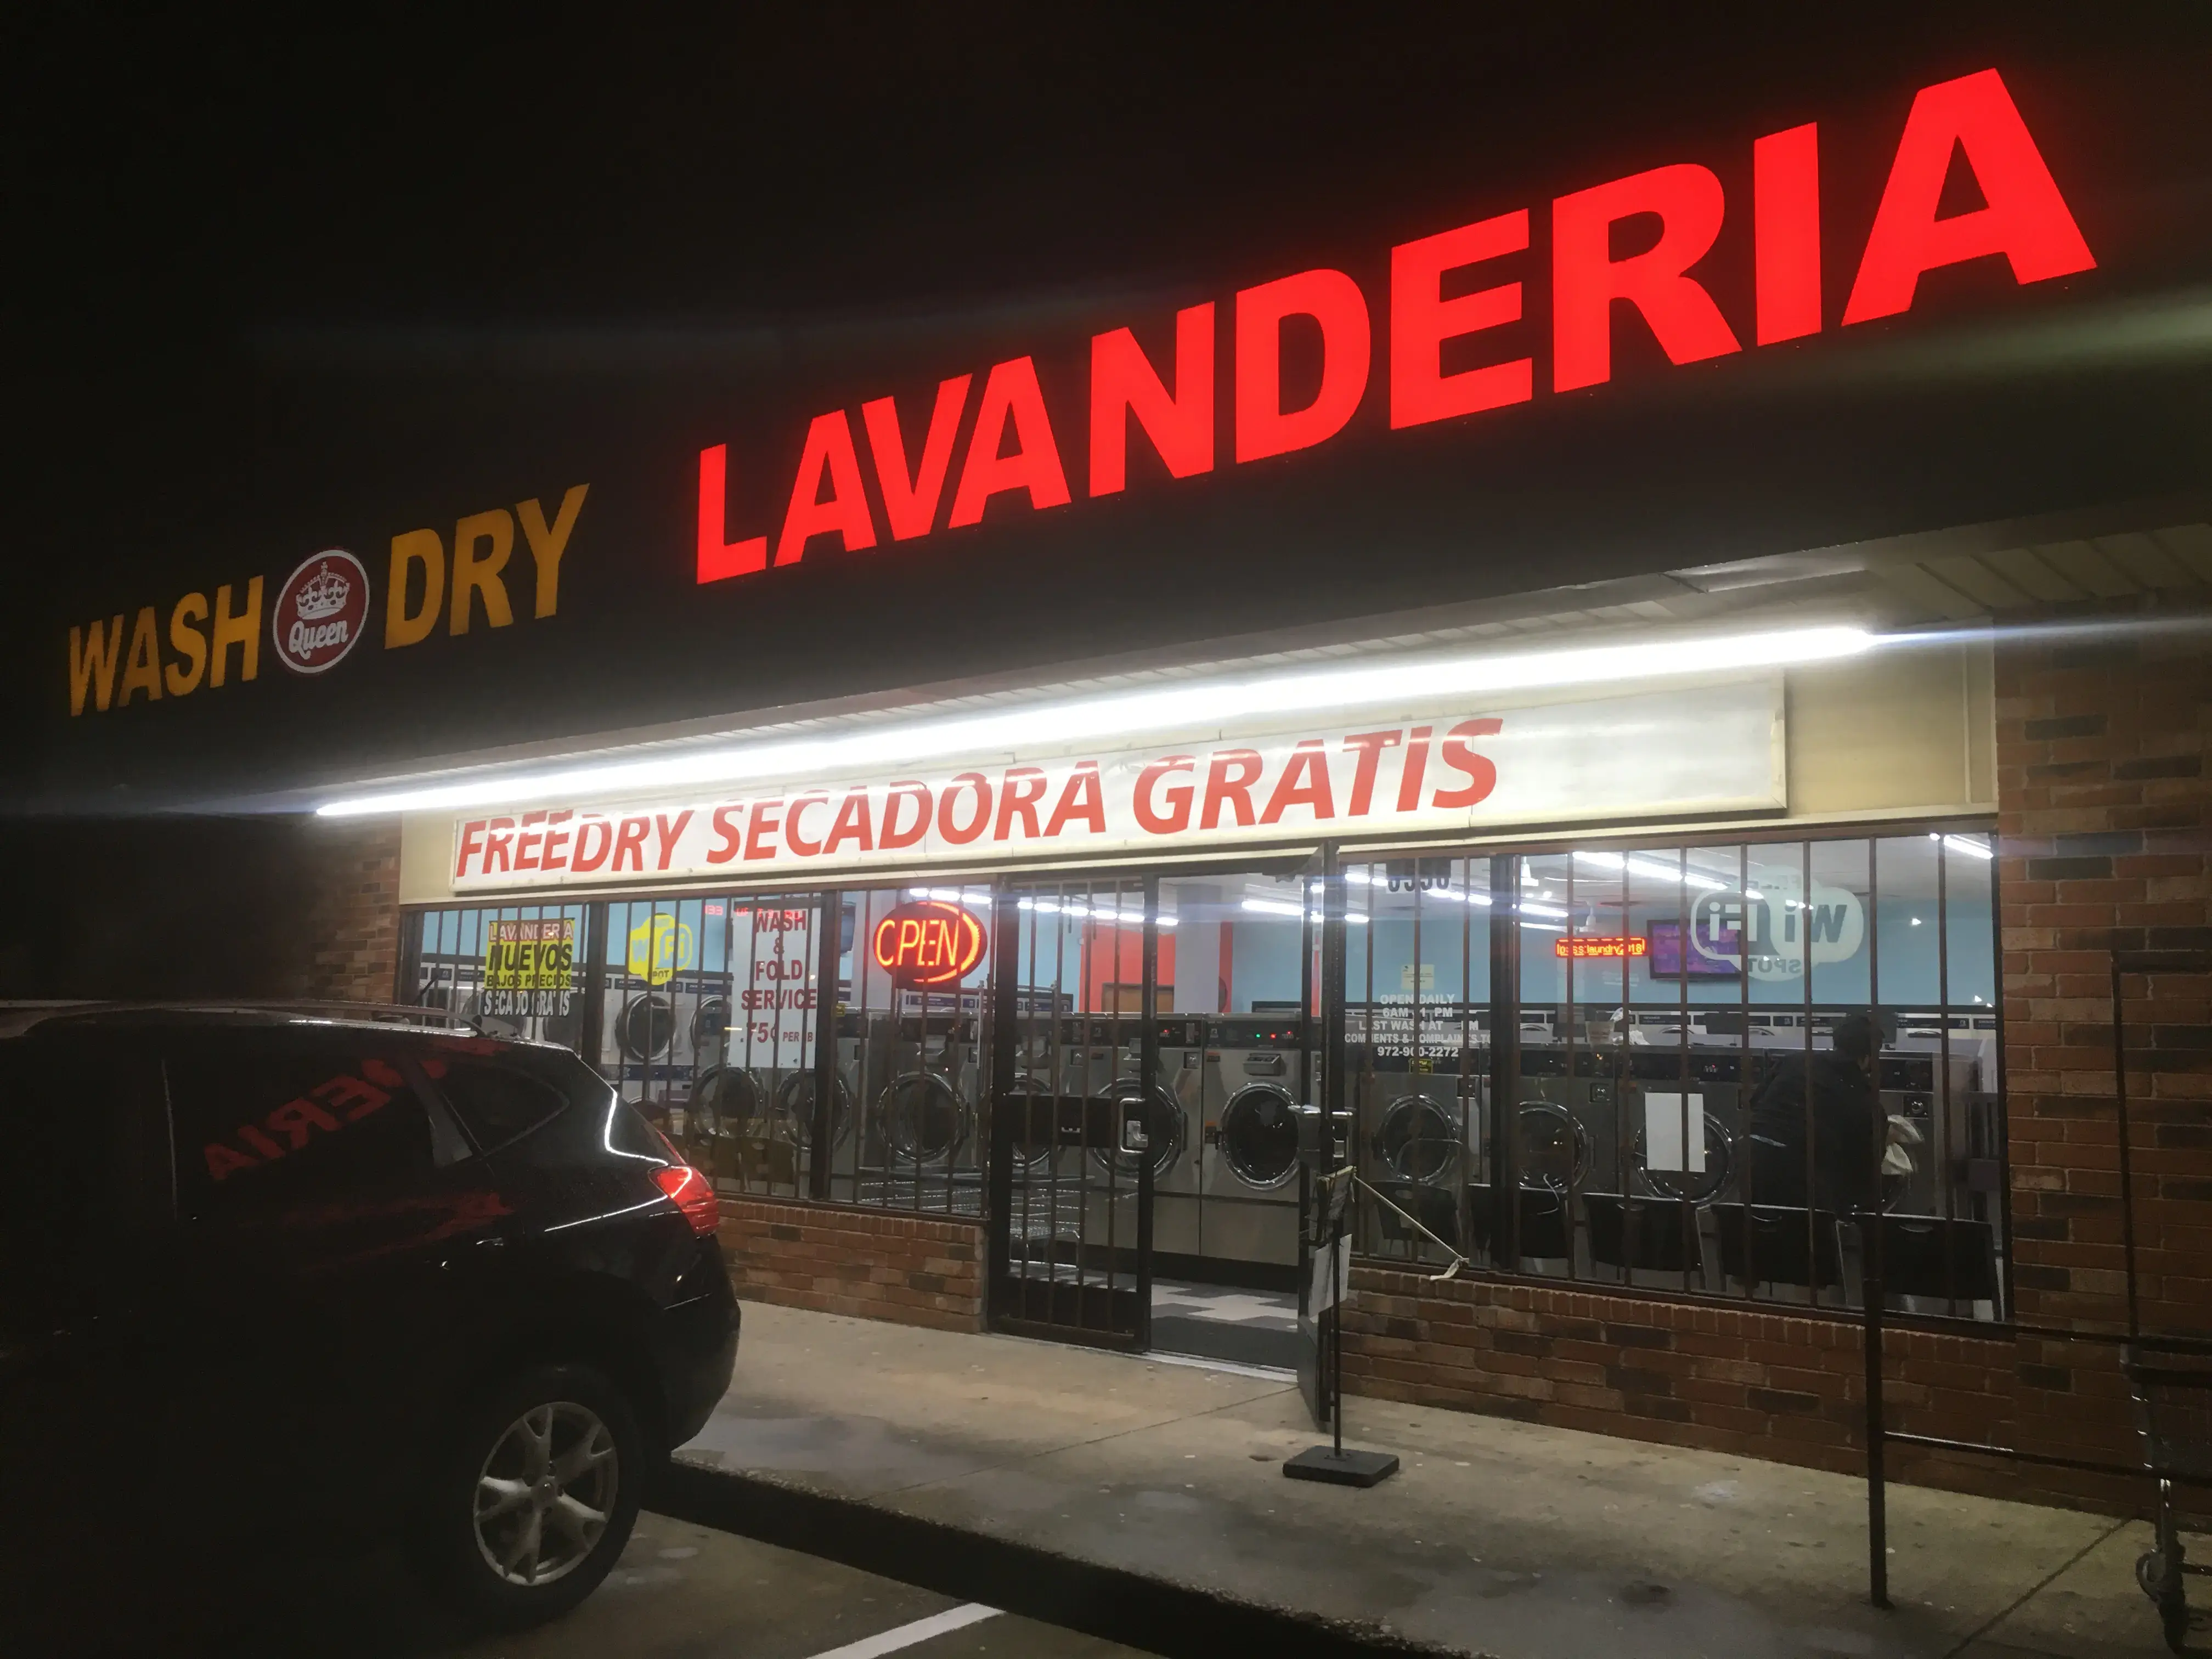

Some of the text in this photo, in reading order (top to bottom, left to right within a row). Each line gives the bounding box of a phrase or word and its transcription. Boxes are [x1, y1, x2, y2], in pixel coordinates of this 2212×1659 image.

[698, 69, 2096, 584] LAVANDERIA
[70, 484, 590, 716] WASH DRY
[289, 620, 349, 660] Queen
[707, 761, 1106, 864] SECADORA
[1133, 718, 1503, 835] GRATIS
[490, 923, 573, 940] LAVNERA
[753, 911, 806, 933] WASH
[756, 960, 802, 981] FOLD
[532, 990, 570, 1015] RAIS
[741, 989, 816, 1010] SERVICE
[1380, 994, 1455, 1004] OPEN DAILY
[1383, 1008, 1408, 1017] 6AM
[1358, 1020, 1387, 1030] LST
[1428, 1020, 1443, 1030] AT
[783, 1031, 799, 1042] PER
[1345, 1034, 1399, 1043] COMENTS
[1412, 1034, 1477, 1043] OMPLAINS
